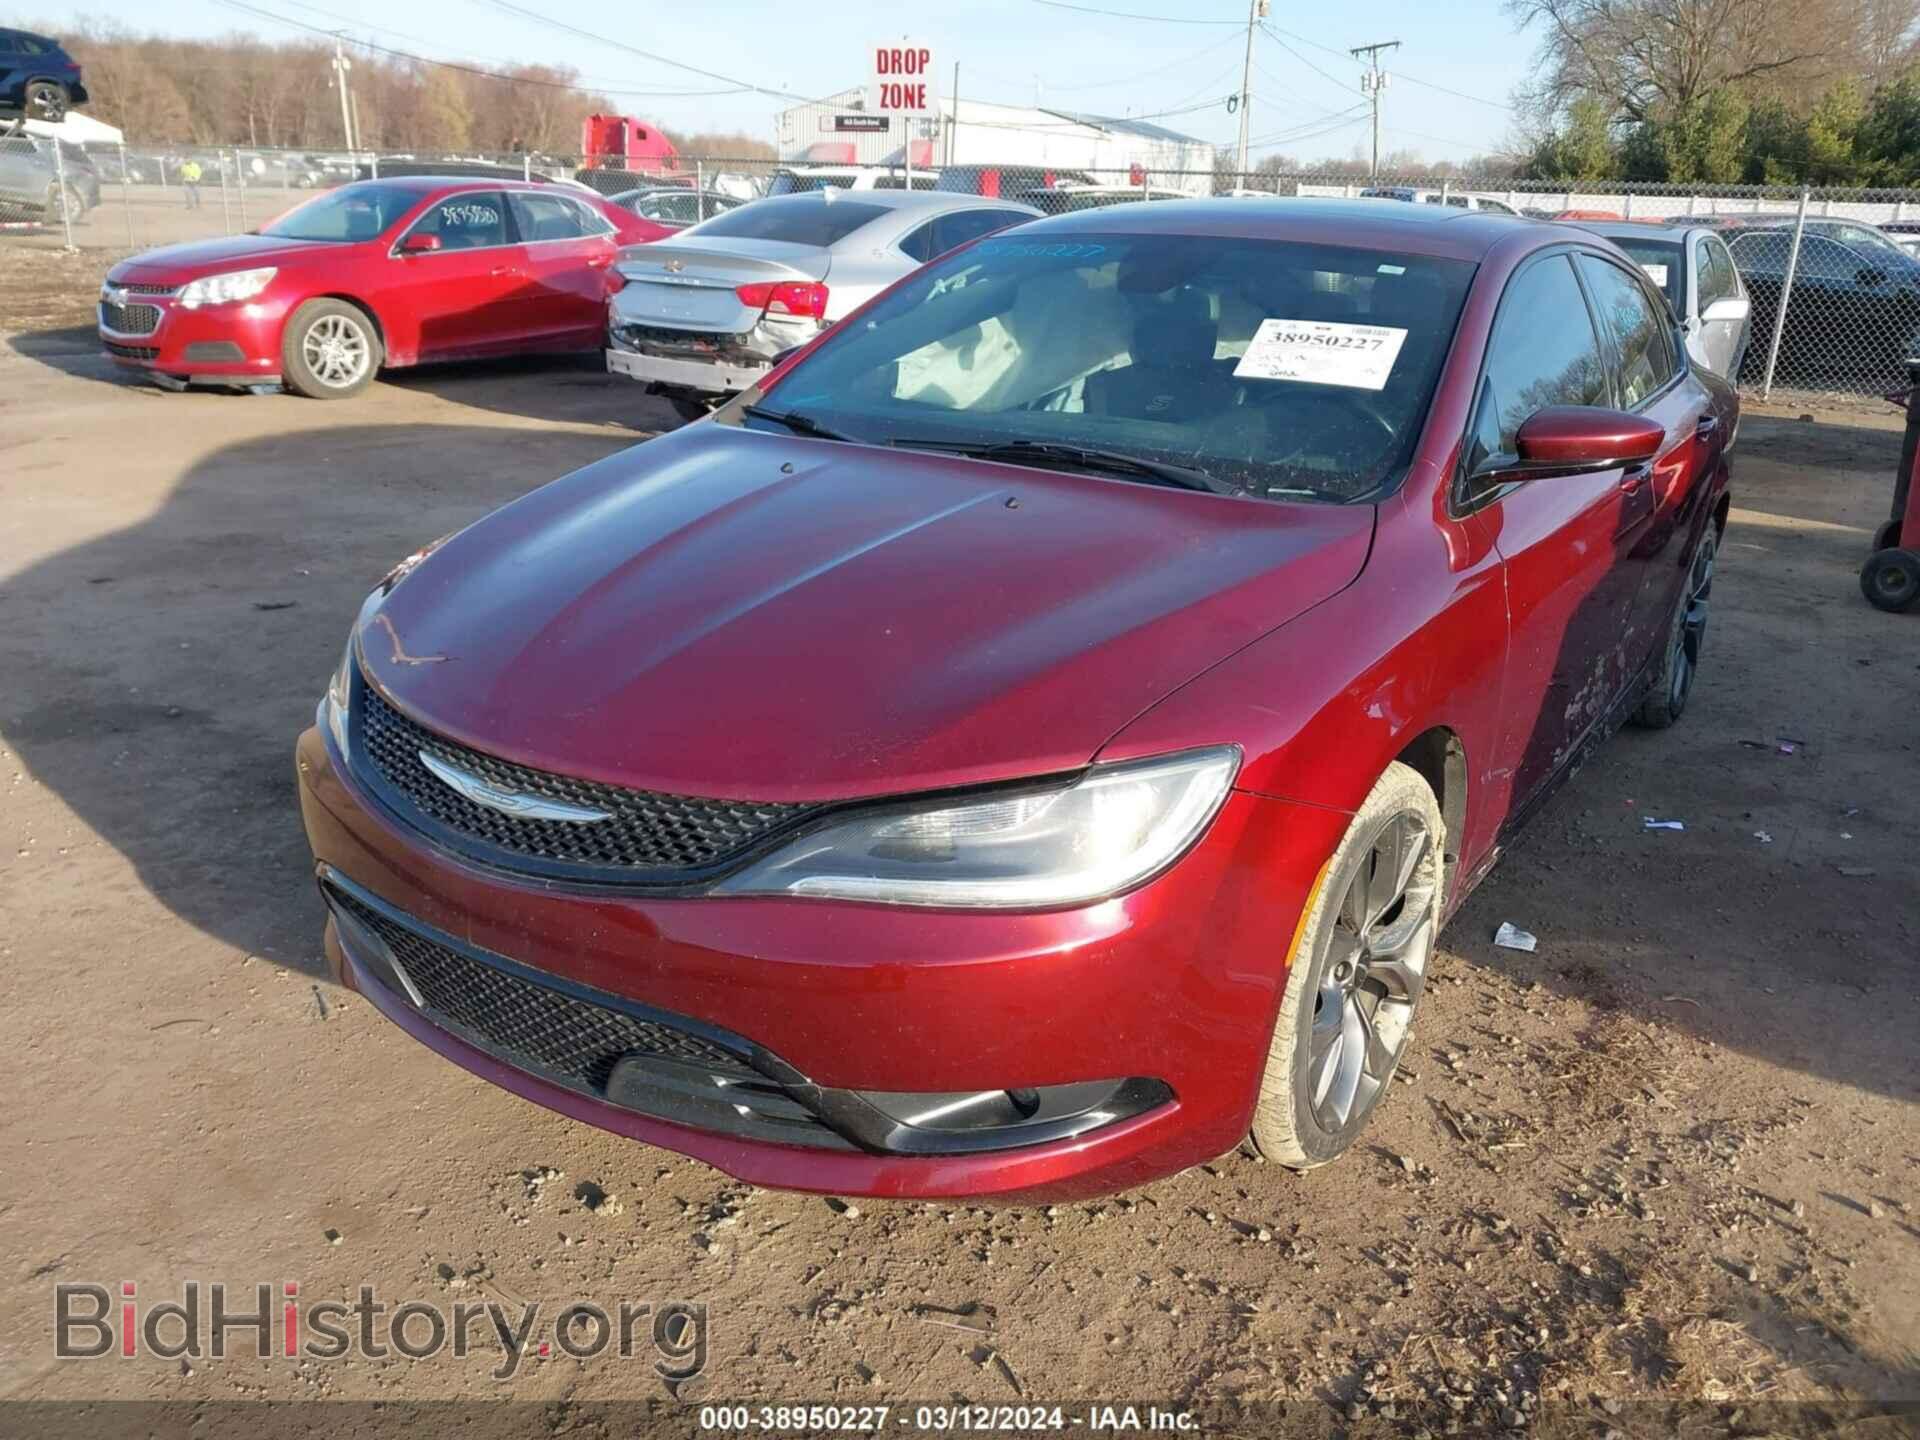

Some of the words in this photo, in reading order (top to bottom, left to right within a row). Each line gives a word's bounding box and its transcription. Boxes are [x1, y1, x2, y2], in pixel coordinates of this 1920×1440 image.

[876, 48, 930, 75] DROP
[880, 83, 926, 109] ZONE
[1267, 331, 1384, 351] 38950227
